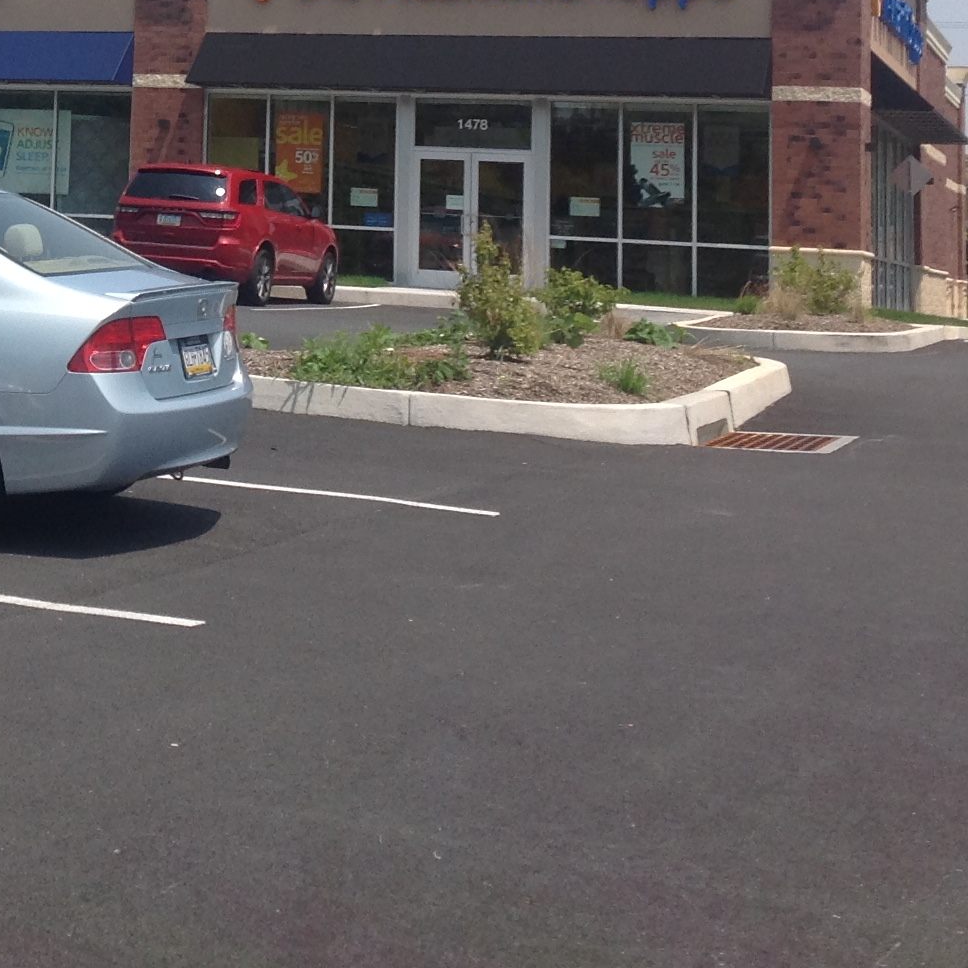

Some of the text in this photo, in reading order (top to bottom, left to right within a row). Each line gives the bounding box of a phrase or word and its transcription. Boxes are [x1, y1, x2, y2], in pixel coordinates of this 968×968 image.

[457, 118, 488, 131] 1478
[16, 127, 53, 137] KNOW
[276, 120, 323, 145] sale
[631, 133, 684, 144] muscle
[652, 148, 677, 159] sale
